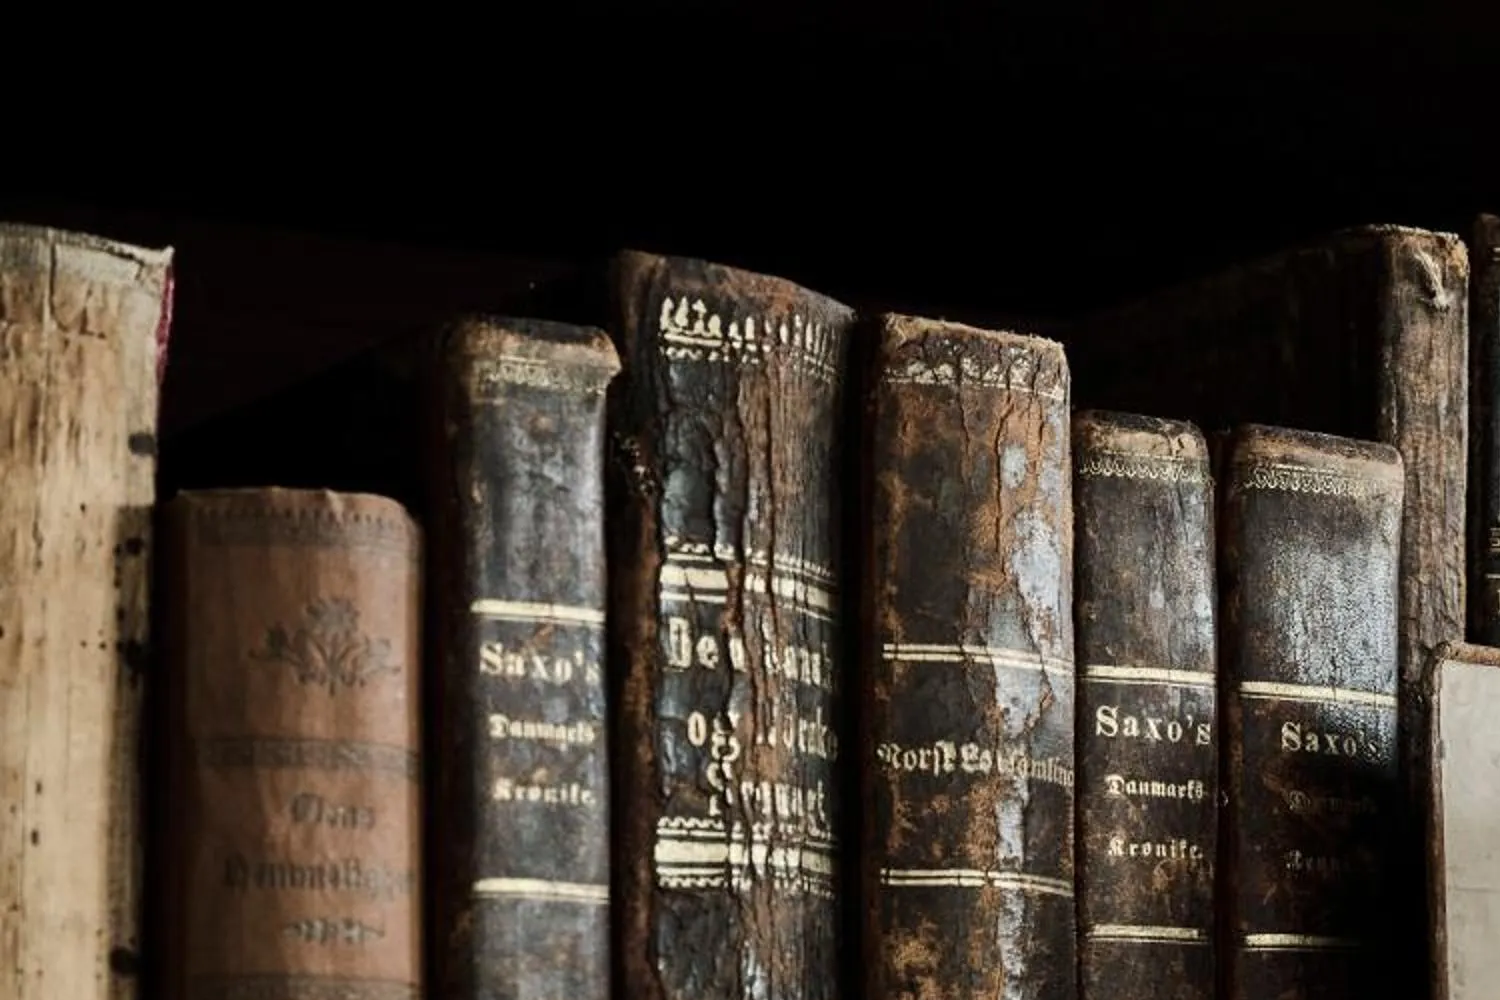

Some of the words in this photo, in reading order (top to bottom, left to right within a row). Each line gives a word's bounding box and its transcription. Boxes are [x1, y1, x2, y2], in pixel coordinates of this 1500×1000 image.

[479, 640, 599, 685] Saxo's
[1095, 704, 1212, 746] Saxo's
[1280, 721, 1381, 760] Saxo's
[1104, 773, 1204, 800] Danmarks
